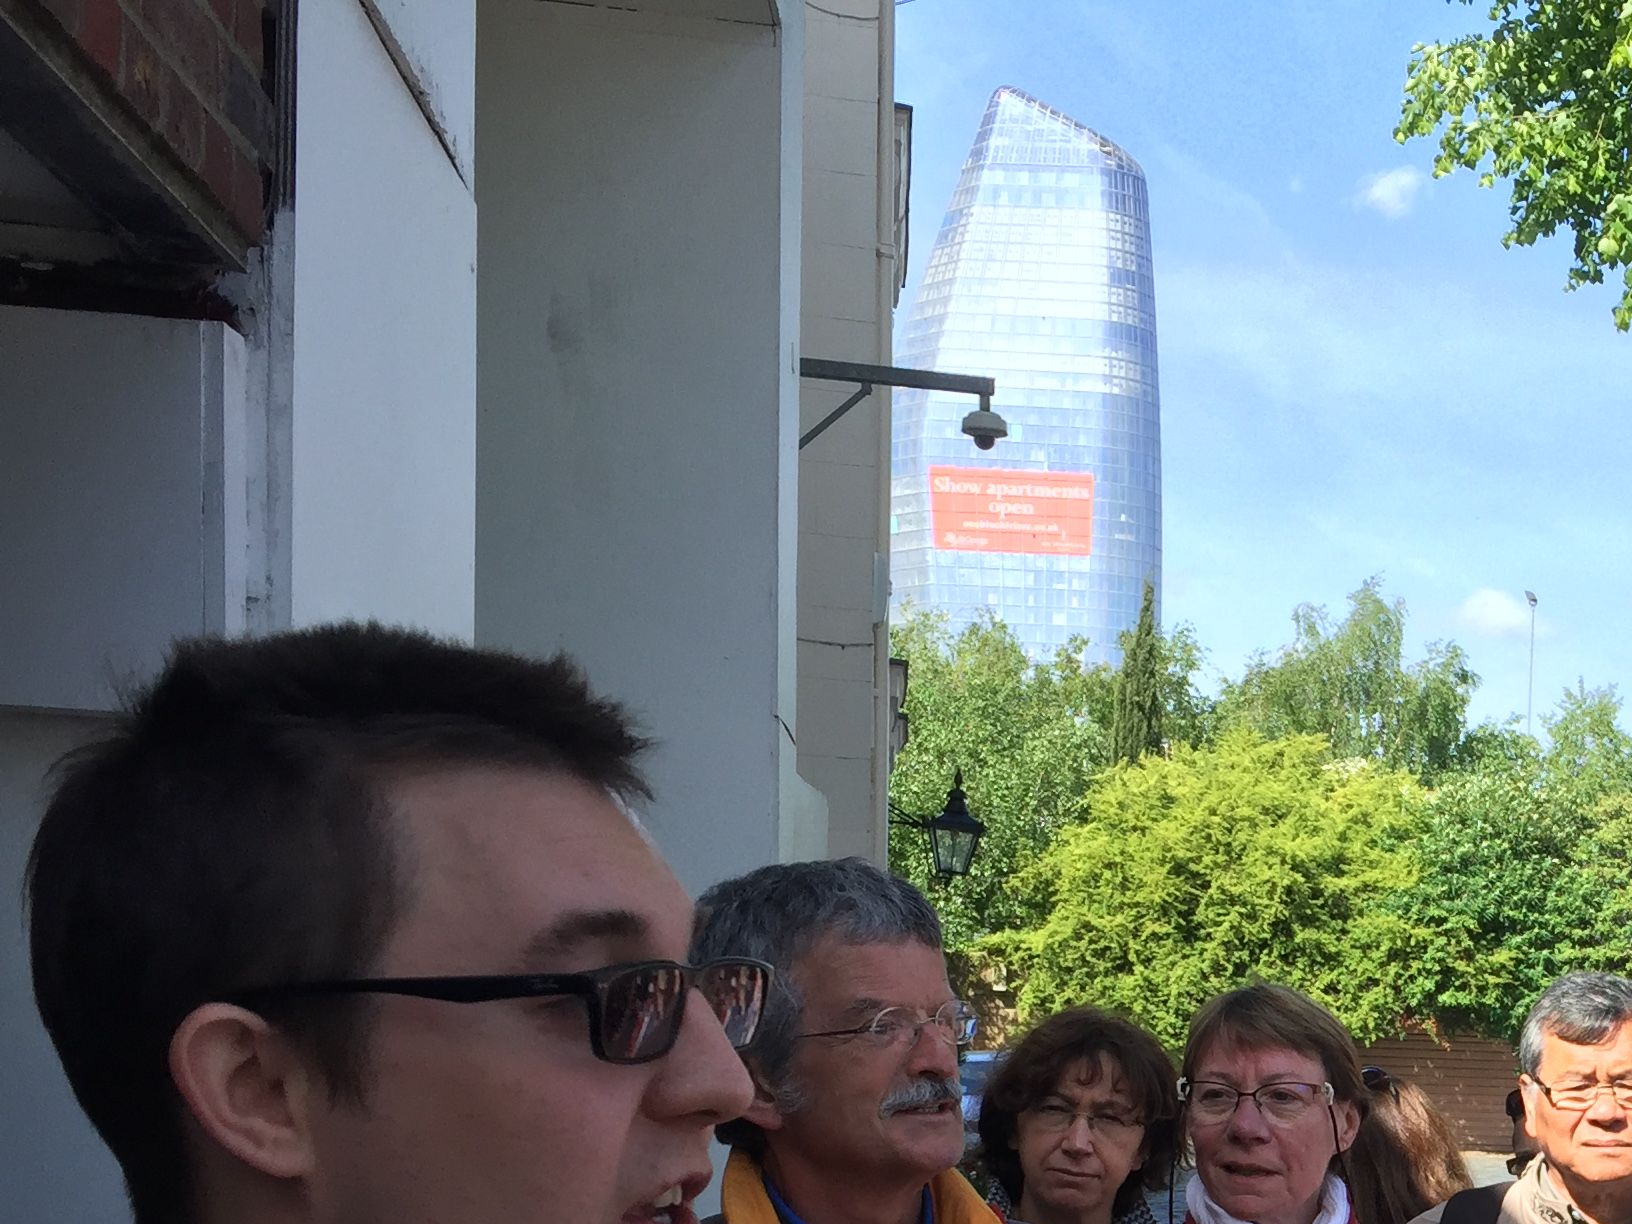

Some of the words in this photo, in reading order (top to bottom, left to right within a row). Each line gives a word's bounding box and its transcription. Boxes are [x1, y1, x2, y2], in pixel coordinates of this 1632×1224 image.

[934, 476, 982, 495] Show
[986, 481, 1090, 501] apartments
[988, 501, 1035, 520] open
